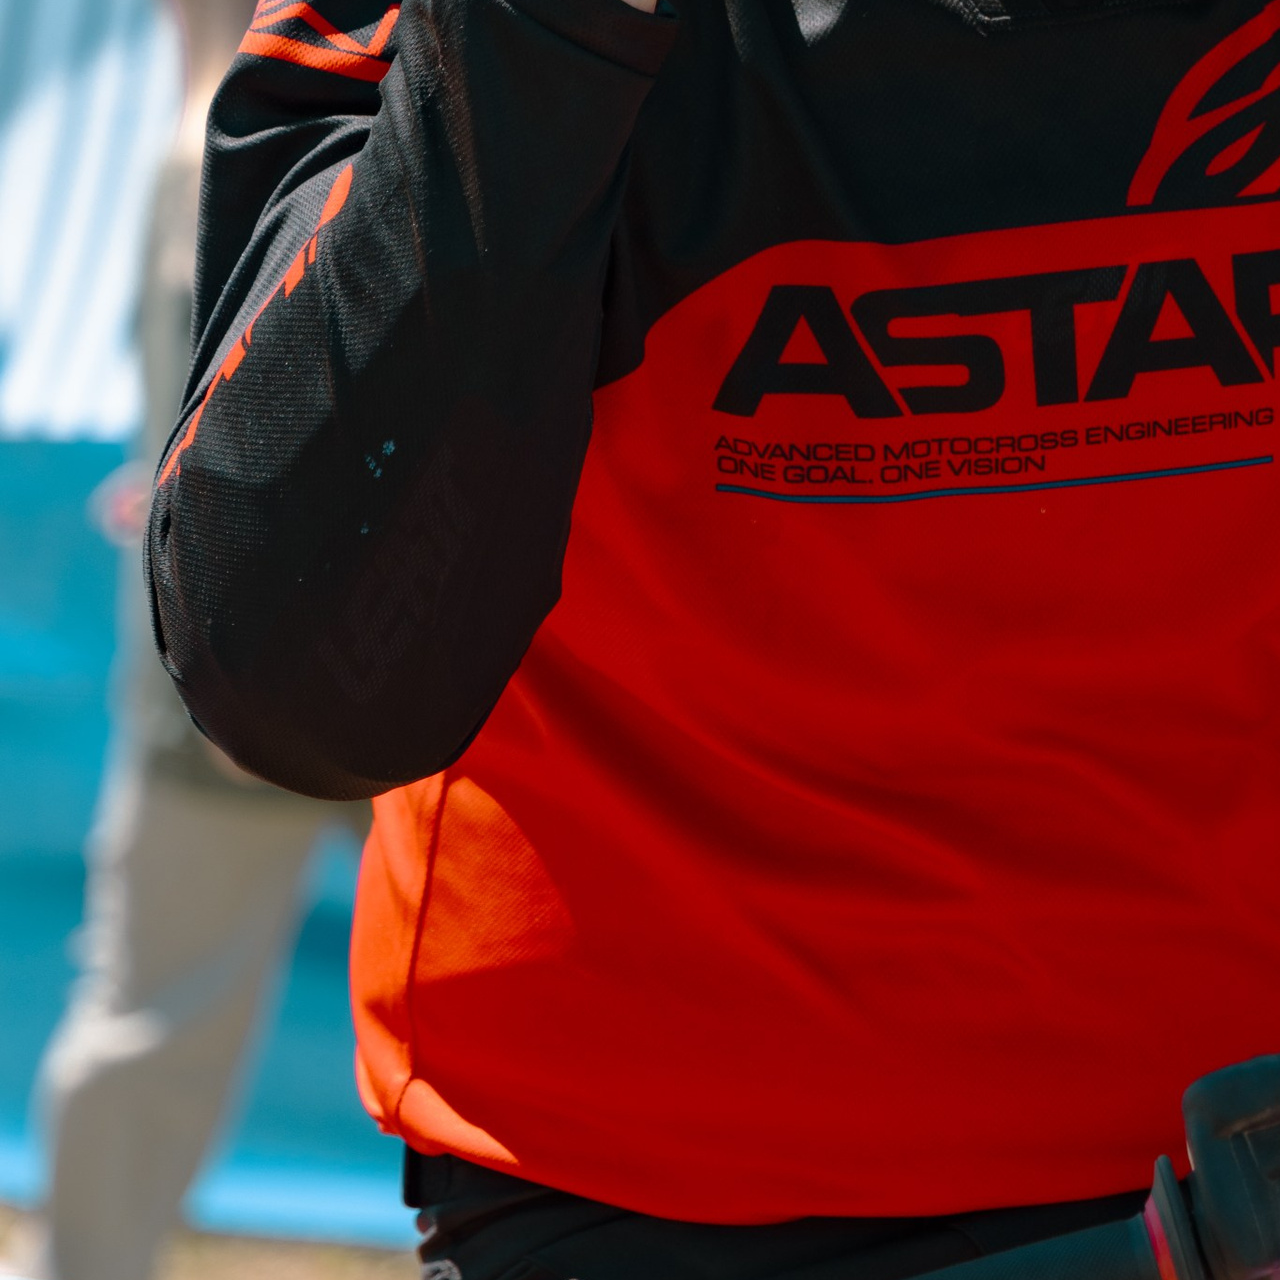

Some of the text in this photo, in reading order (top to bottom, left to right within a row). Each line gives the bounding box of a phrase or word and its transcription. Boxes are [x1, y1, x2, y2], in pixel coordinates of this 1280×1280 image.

[714, 407, 1274, 463] ADVANCED MOTOCROSS ENGINEERING
[717, 454, 1046, 484] ONE GOAL. ONE VISION
